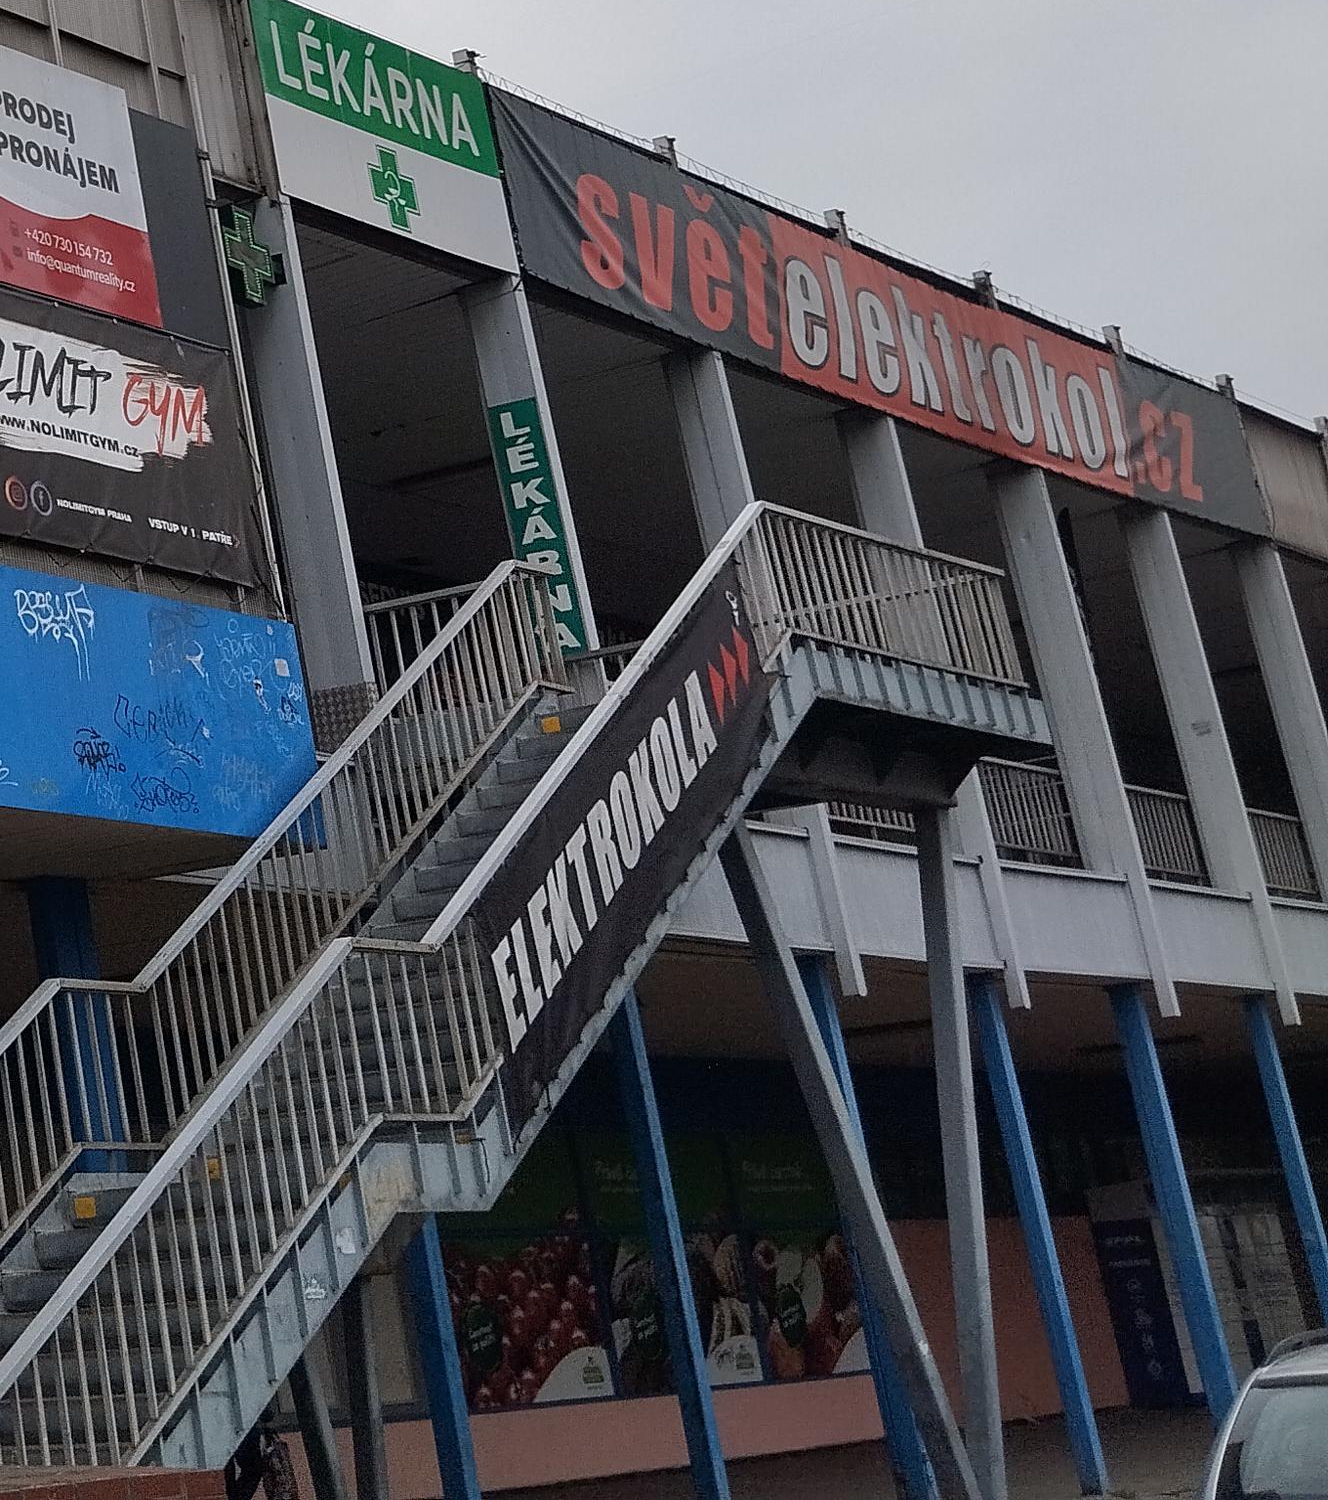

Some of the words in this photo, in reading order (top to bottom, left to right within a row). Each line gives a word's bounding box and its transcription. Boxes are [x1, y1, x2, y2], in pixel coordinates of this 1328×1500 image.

[270, 18, 480, 158] LÉKÁRNA
[26, 247, 136, 293] info@quantumreality.cz
[122, 373, 205, 457] GYM
[107, 508, 132, 523] PRAHA
[148, 517, 180, 535] VSTUP
[180, 525, 188, 537] V
[201, 528, 233, 547] PATŘE
[491, 670, 718, 1053] ELEKTROKOLA
